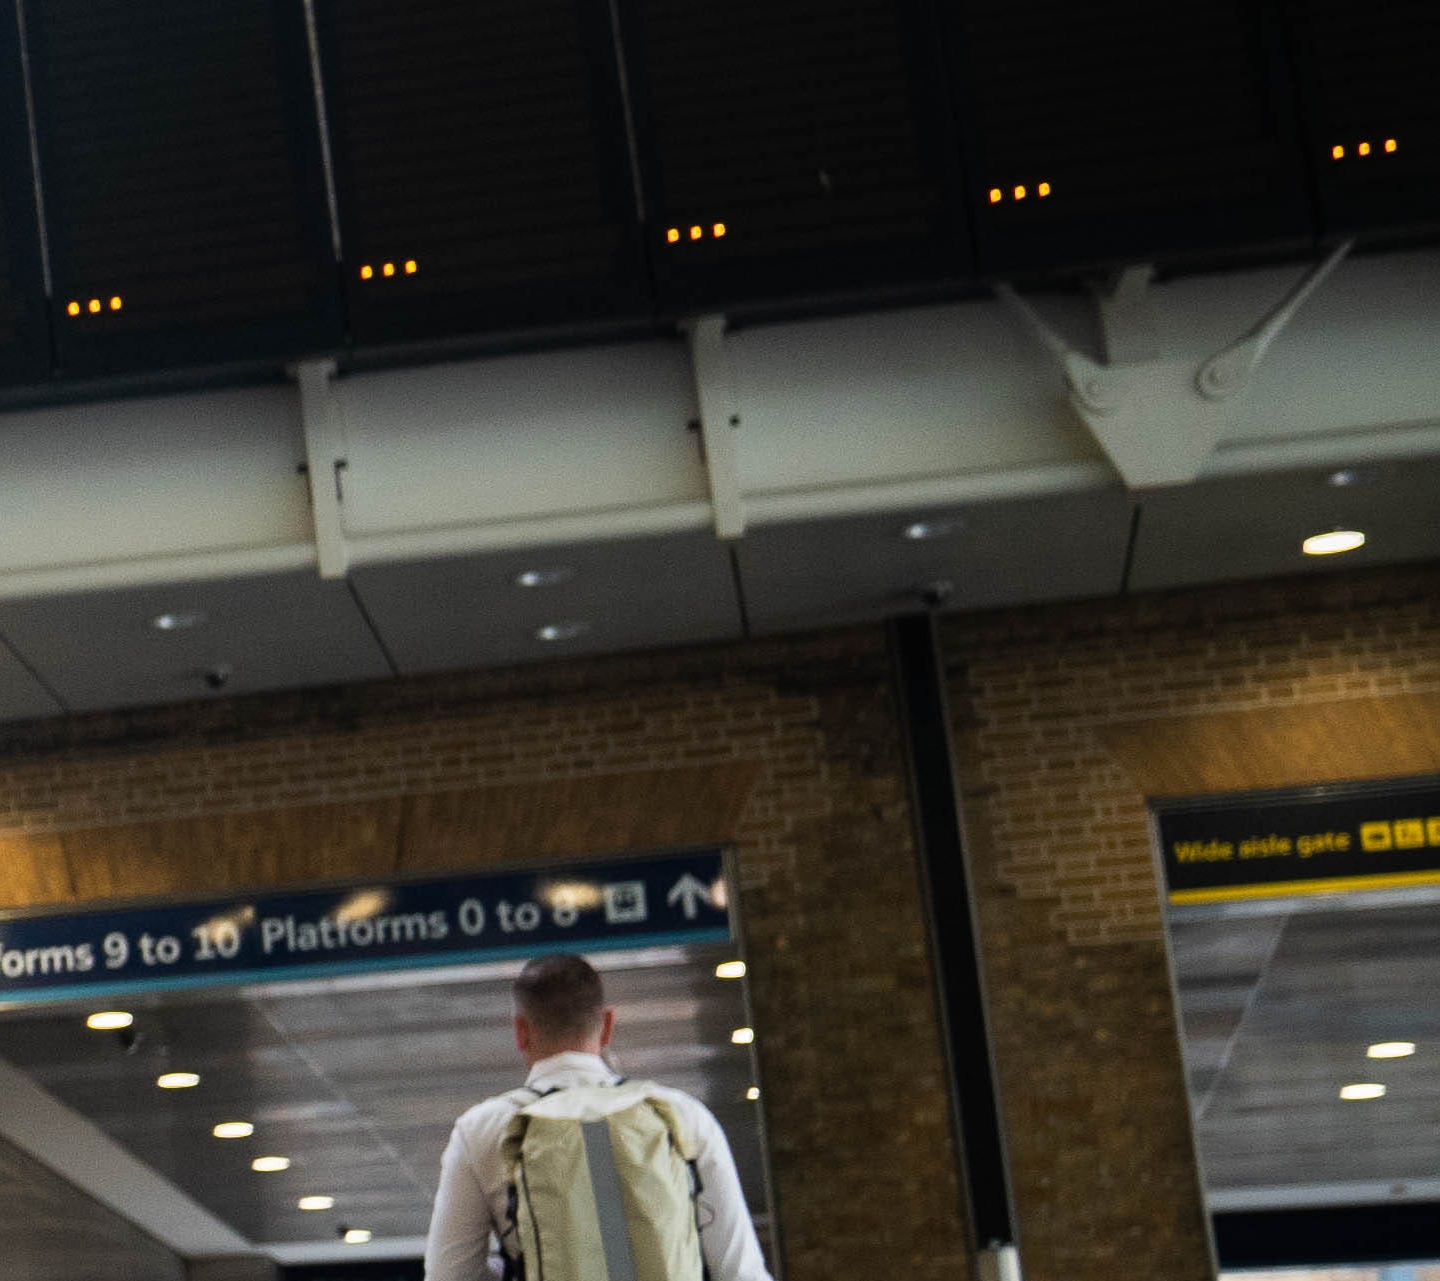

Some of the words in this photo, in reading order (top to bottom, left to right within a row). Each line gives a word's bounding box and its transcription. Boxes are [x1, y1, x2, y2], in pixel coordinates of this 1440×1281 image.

[1174, 837, 1234, 864] Wide
[1238, 833, 1292, 859] aisle
[1296, 831, 1351, 859] gate
[261, 911, 449, 953] Platforms
[458, 903, 485, 935] 0
[496, 898, 540, 931] to
[103, 940, 127, 968] 9
[140, 936, 180, 966] to
[193, 926, 241, 961] 10
